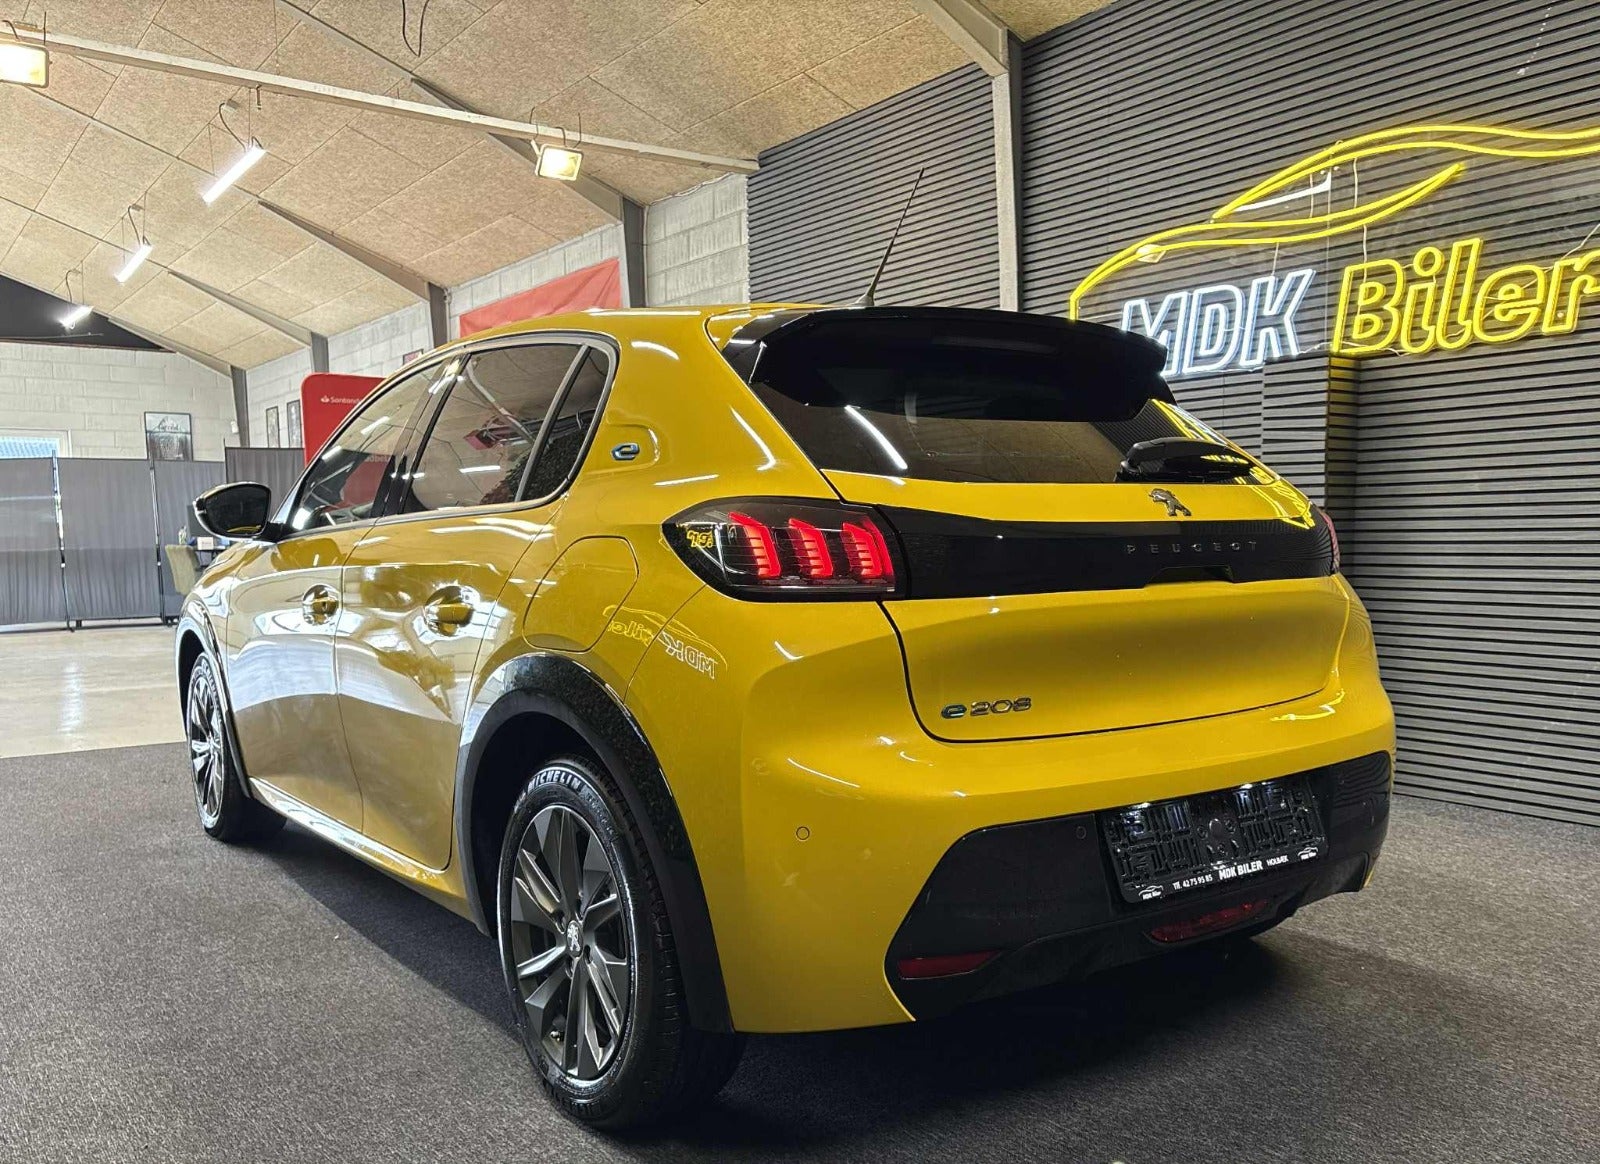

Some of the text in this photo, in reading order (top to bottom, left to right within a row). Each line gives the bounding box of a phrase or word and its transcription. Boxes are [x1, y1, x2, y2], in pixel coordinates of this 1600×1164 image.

[1121, 237, 1600, 377] MDK Biler
[330, 396, 361, 404] Santand
[1126, 540, 1257, 555] PEUGEOT
[527, 770, 581, 795] MICHELIN
[1219, 866, 1237, 880] MDK
[1237, 860, 1264, 876] BILER
